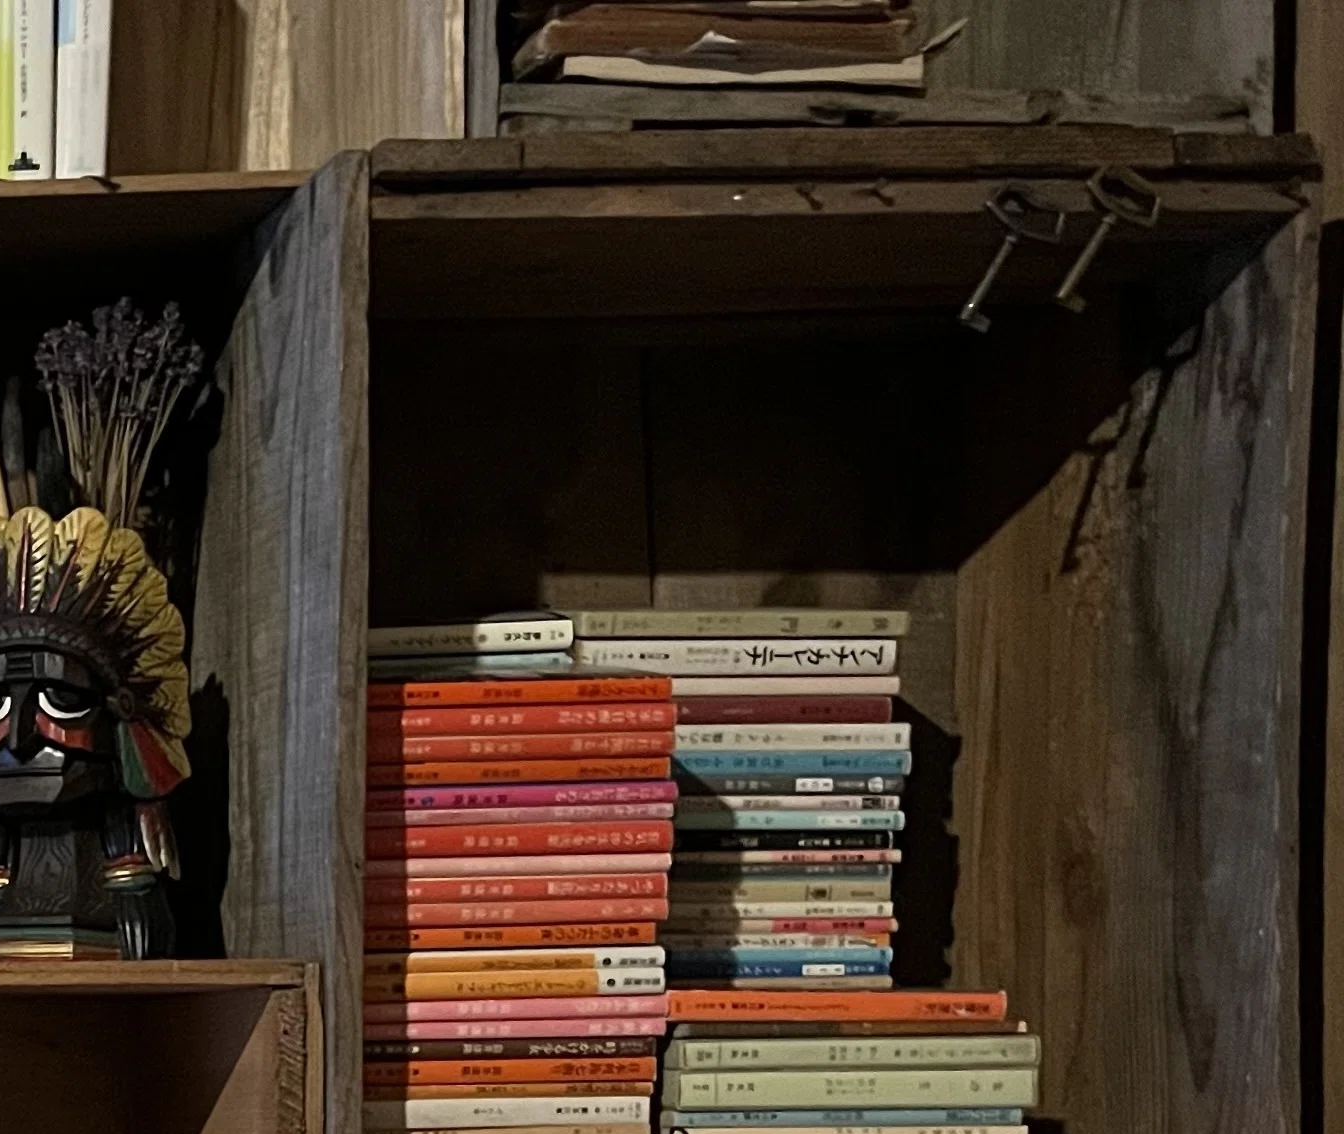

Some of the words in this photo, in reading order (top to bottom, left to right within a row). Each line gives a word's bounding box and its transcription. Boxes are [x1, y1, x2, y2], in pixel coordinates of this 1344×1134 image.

[744, 645, 883, 667] アンナ・カレーニナ
